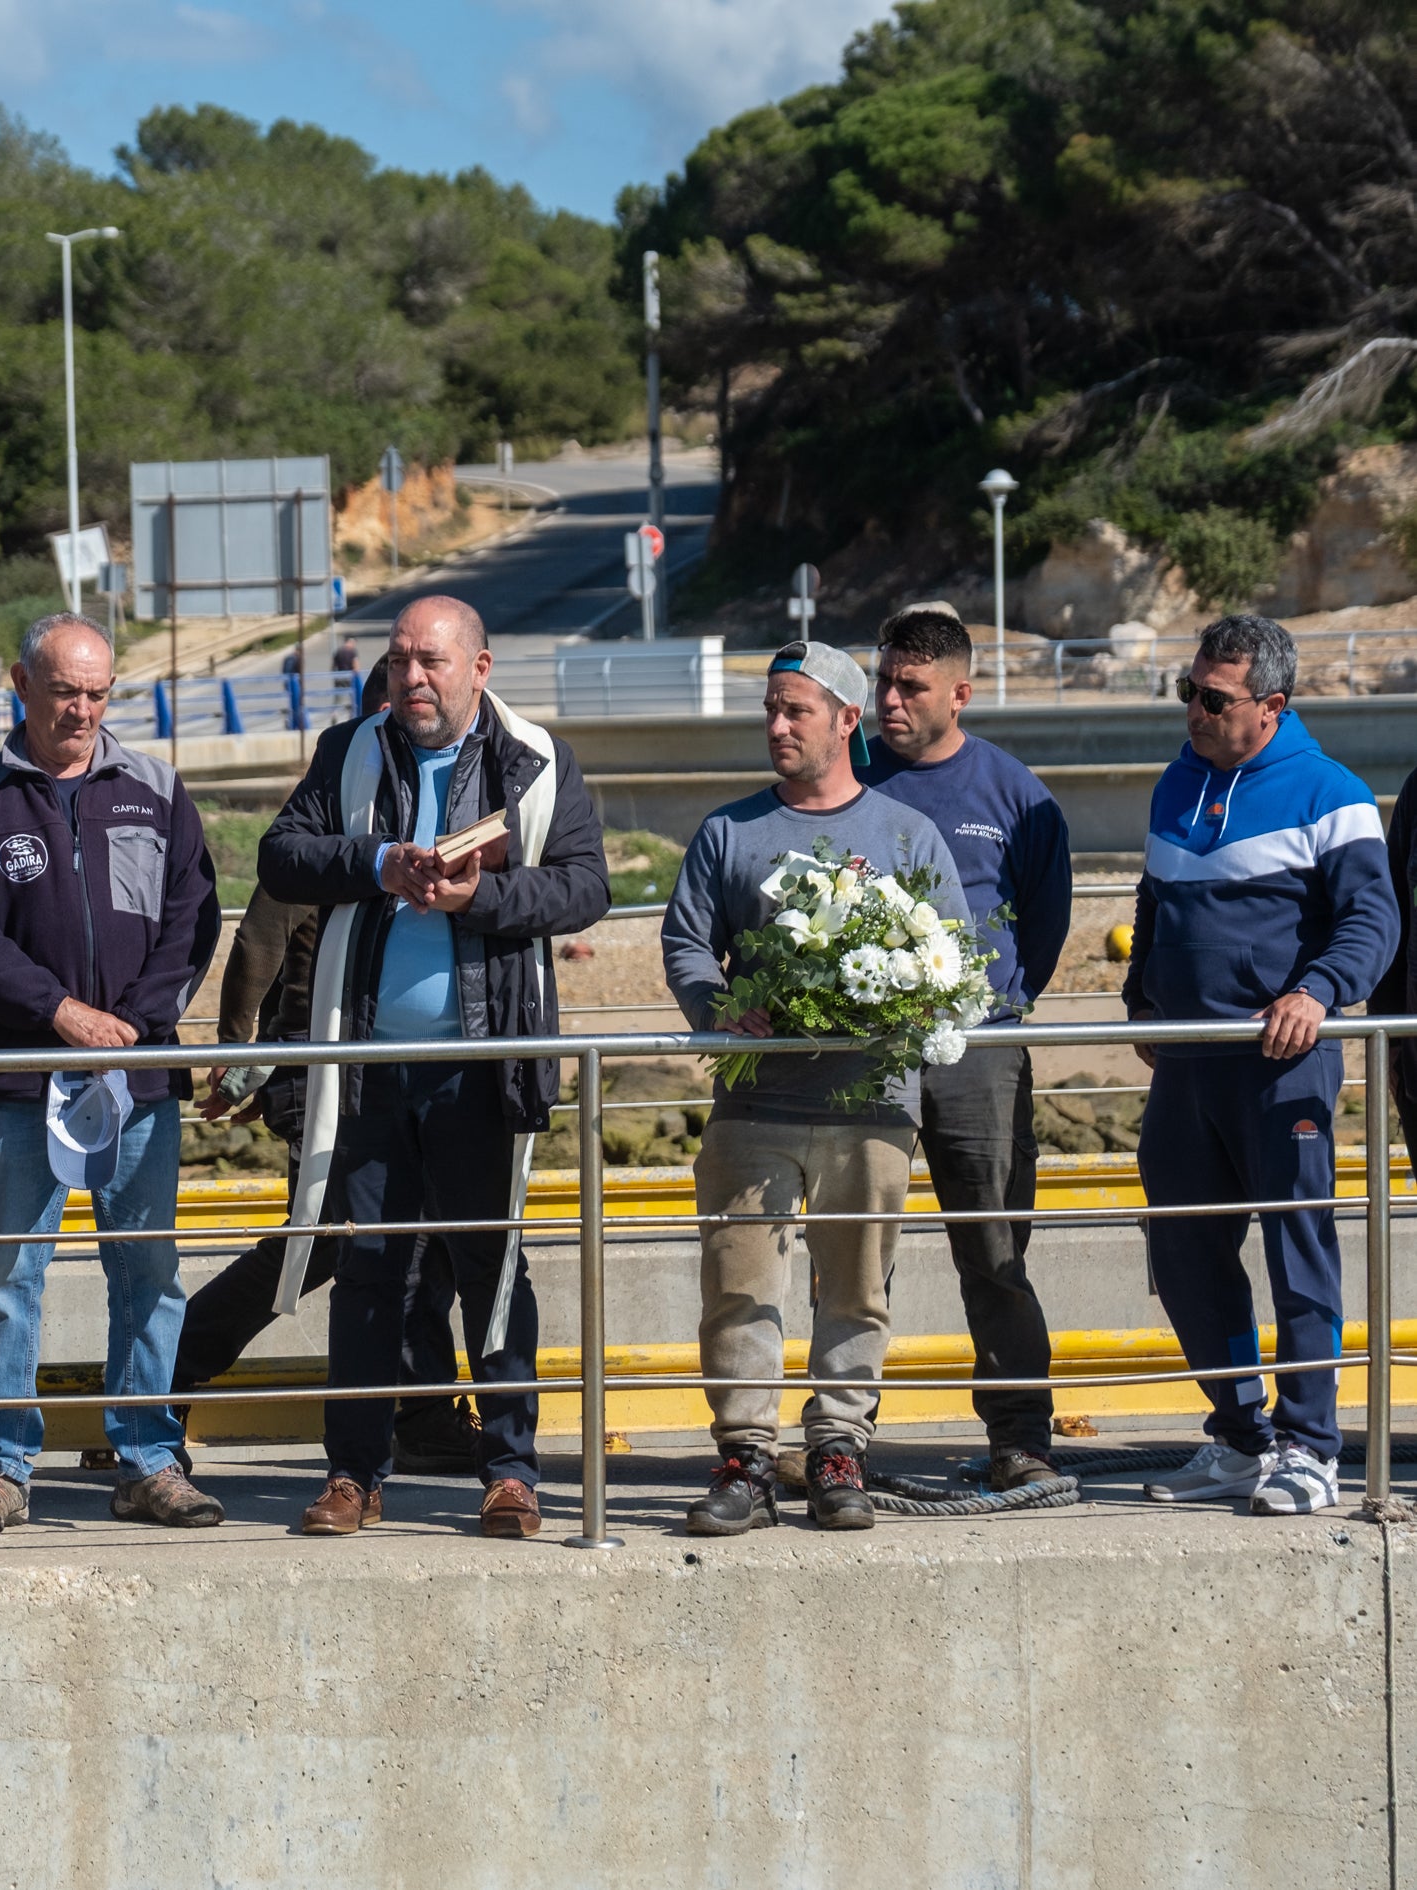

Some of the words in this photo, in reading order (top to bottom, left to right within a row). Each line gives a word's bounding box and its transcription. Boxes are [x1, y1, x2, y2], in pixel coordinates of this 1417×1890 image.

[112, 804, 153, 815] CAPITAN
[955, 828, 977, 836] PUNTA
[961, 823, 1002, 835] ALMADRABA
[6, 854, 43, 871] GADIRA
